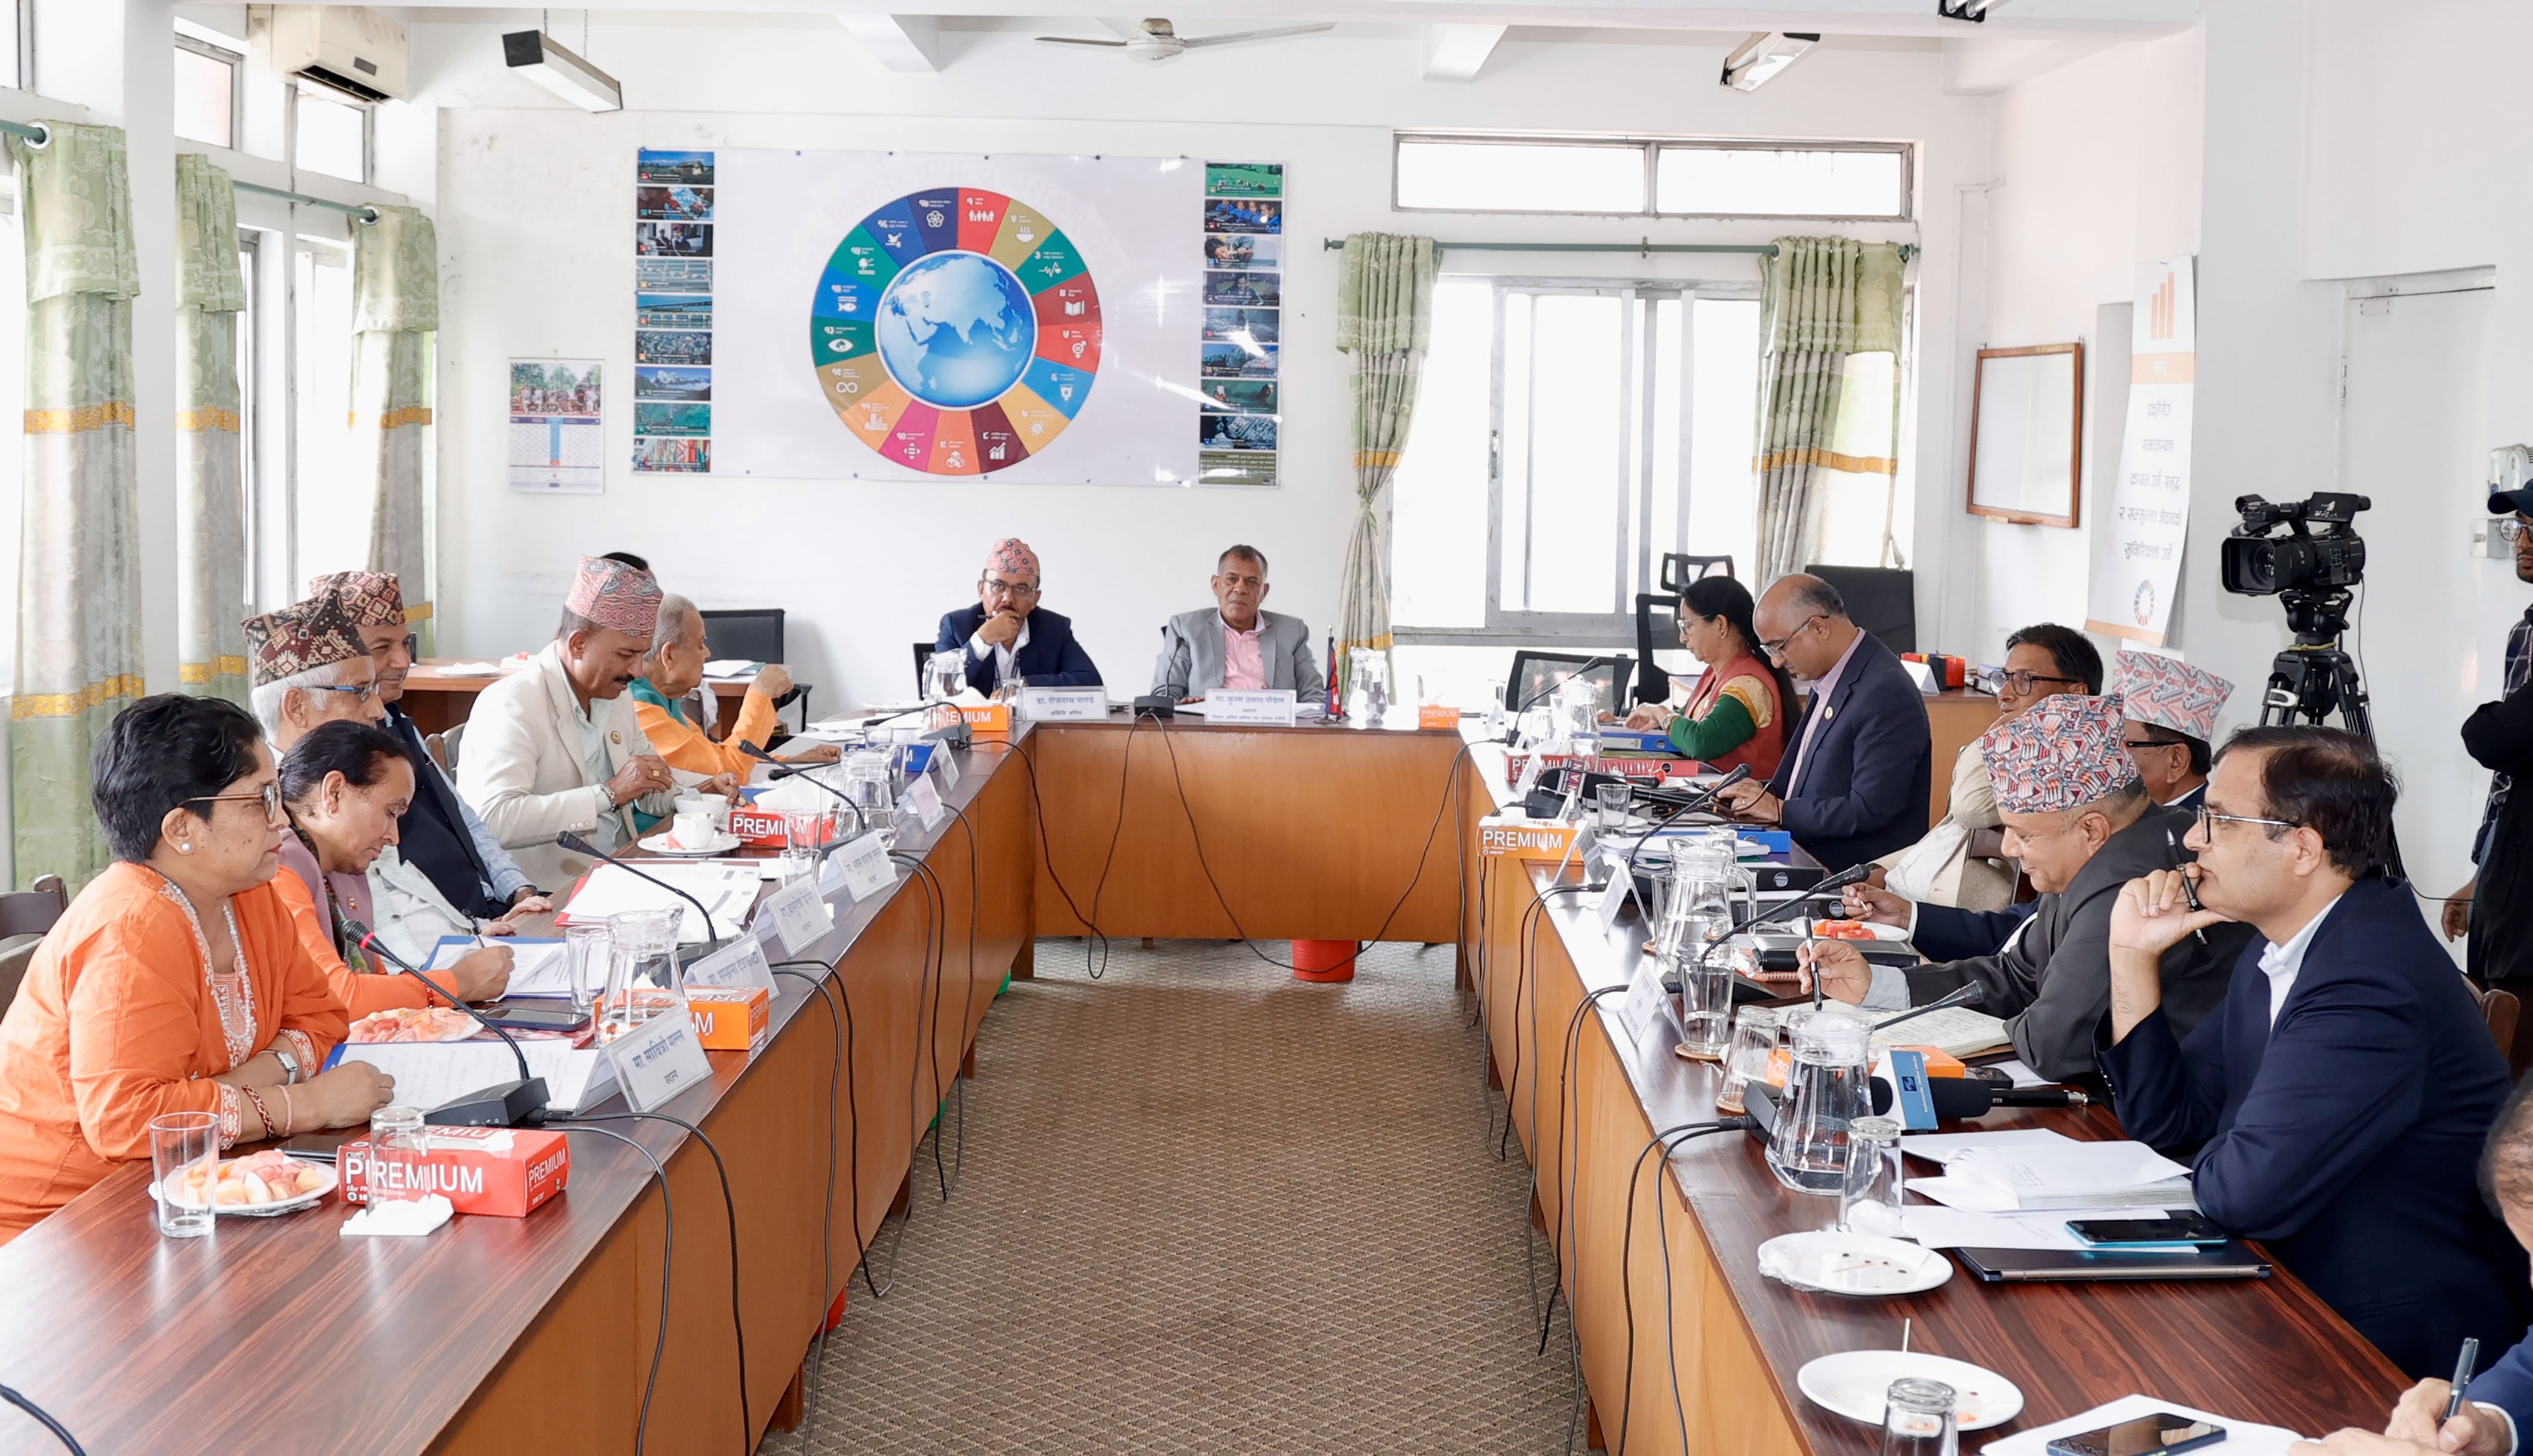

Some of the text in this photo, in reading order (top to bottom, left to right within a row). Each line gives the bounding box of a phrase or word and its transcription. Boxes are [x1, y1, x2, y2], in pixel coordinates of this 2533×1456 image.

[2119, 506, 2125, 519] र
[1421, 708, 1457, 717] PREMIUM
[1483, 830, 1562, 849] PREMIUM
[632, 1054, 647, 1069] मा.
[528, 1147, 566, 1188] PREMIUM
